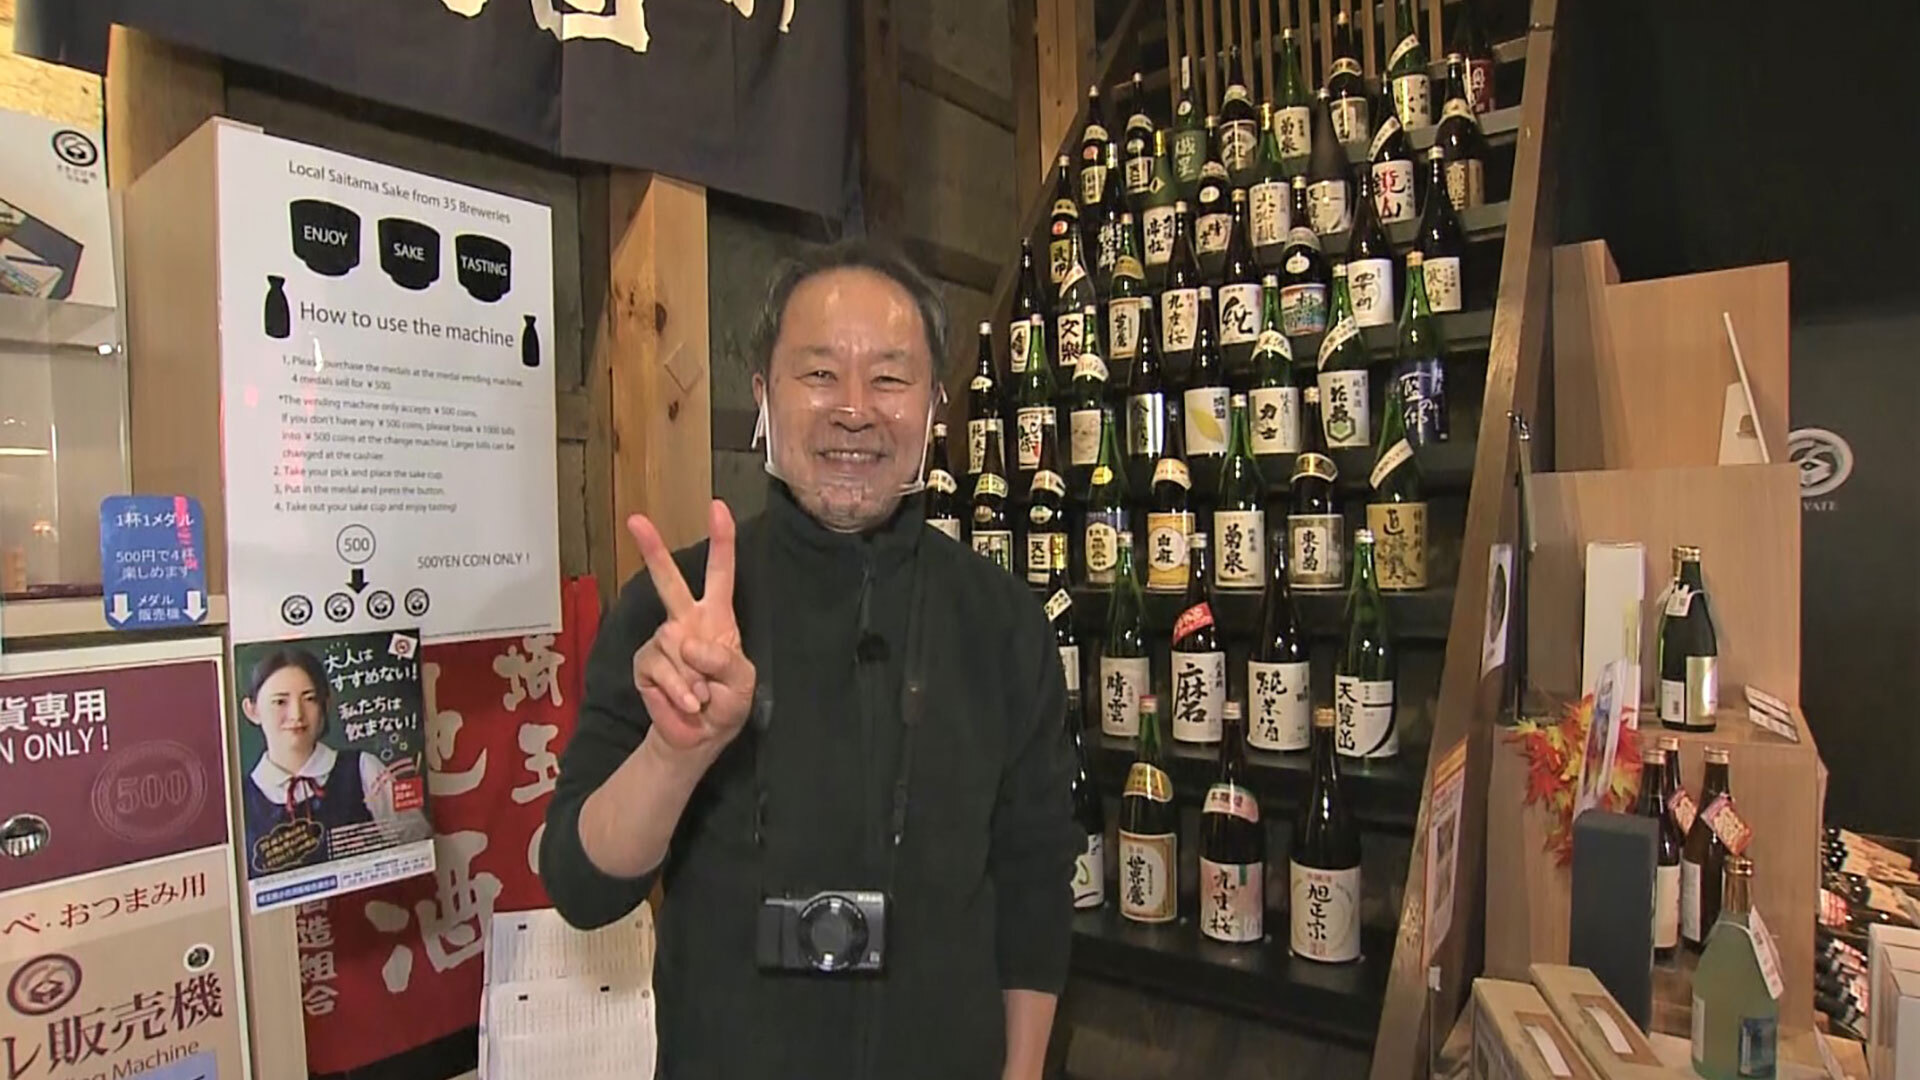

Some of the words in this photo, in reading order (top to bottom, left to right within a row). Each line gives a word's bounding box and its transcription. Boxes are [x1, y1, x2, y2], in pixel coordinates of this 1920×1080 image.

[289, 160, 325, 181] Local
[329, 168, 379, 194] Saitama
[381, 181, 409, 201] Sake
[412, 189, 440, 208] from
[443, 196, 457, 211] 35
[459, 201, 511, 223] Breweries
[303, 225, 348, 247] ENJOY
[393, 243, 425, 262] SAKE
[460, 255, 508, 277] TASTING
[300, 301, 346, 326] How
[352, 309, 371, 328] to
[377, 315, 408, 334] use
[412, 314, 441, 338] the
[446, 322, 515, 348] machine
[292, 373, 298, 382] 4
[300, 375, 333, 386] medals
[336, 377, 350, 387] sell
[352, 378, 363, 388] for
[324, 360, 364, 371] purchase
[366, 362, 380, 372] the
[382, 365, 411, 376] medals
[413, 368, 420, 376] at
[422, 368, 434, 378] the
[462, 373, 491, 386] vending
[304, 397, 341, 410] vending
[343, 400, 378, 410] machine
[381, 401, 399, 414] only
[401, 405, 431, 415] accepts
[290, 415, 308, 425] you
[310, 413, 334, 425] don't
[336, 415, 357, 426] have
[359, 418, 375, 429] any
[426, 422, 450, 433] please
[452, 423, 473, 434] break
[501, 427, 515, 437] bills
[1260, 402, 1278, 440] 力士
[282, 432, 301, 442] into
[332, 435, 356, 444] coins
[358, 436, 366, 445] at
[367, 435, 382, 445] the
[384, 436, 412, 449] change
[451, 439, 475, 451] Larger
[476, 441, 490, 450] bills
[491, 443, 503, 451] can
[506, 442, 515, 451] be
[282, 448, 323, 461] changed
[325, 451, 334, 459] at
[336, 450, 351, 460] the
[284, 466, 306, 477] Take
[308, 468, 329, 479] your
[331, 469, 349, 480] pick
[351, 469, 368, 478] and
[370, 470, 392, 481] place
[394, 470, 407, 479] the
[409, 471, 426, 479] sake
[285, 484, 300, 494] Put
[303, 485, 312, 494] in
[314, 485, 328, 494] the
[331, 485, 359, 495] medal
[361, 485, 377, 495] and
[379, 487, 400, 498] press
[402, 486, 415, 496] the
[286, 502, 307, 512] Take
[309, 502, 325, 512] out
[327, 503, 347, 515] your
[349, 502, 368, 513] sake
[370, 503, 387, 514] cup
[388, 502, 404, 512] and
[405, 503, 427, 515] enjoy
[116, 512, 194, 528] 1杯1メダル
[344, 537, 370, 553] 500
[1224, 523, 1248, 574] 菊泉
[1301, 530, 1320, 571] 東白菊
[116, 549, 196, 564] 500円で4杯
[417, 554, 460, 569] 500YEN
[462, 554, 491, 568] COIN
[122, 566, 190, 580] 楽しめます
[138, 594, 175, 607] メダル
[138, 608, 181, 621] 販売機
[324, 648, 374, 674] 大人は
[338, 696, 402, 720] 私たちは
[1106, 671, 1127, 723] 晴雲
[1256, 670, 1287, 742] 純米酒
[1338, 682, 1358, 751] 天覧山
[117, 770, 187, 814] 500
[1213, 868, 1237, 935] 九重桜
[1306, 883, 1332, 940] 旭正宗
[112, 1039, 200, 1076] Machine
